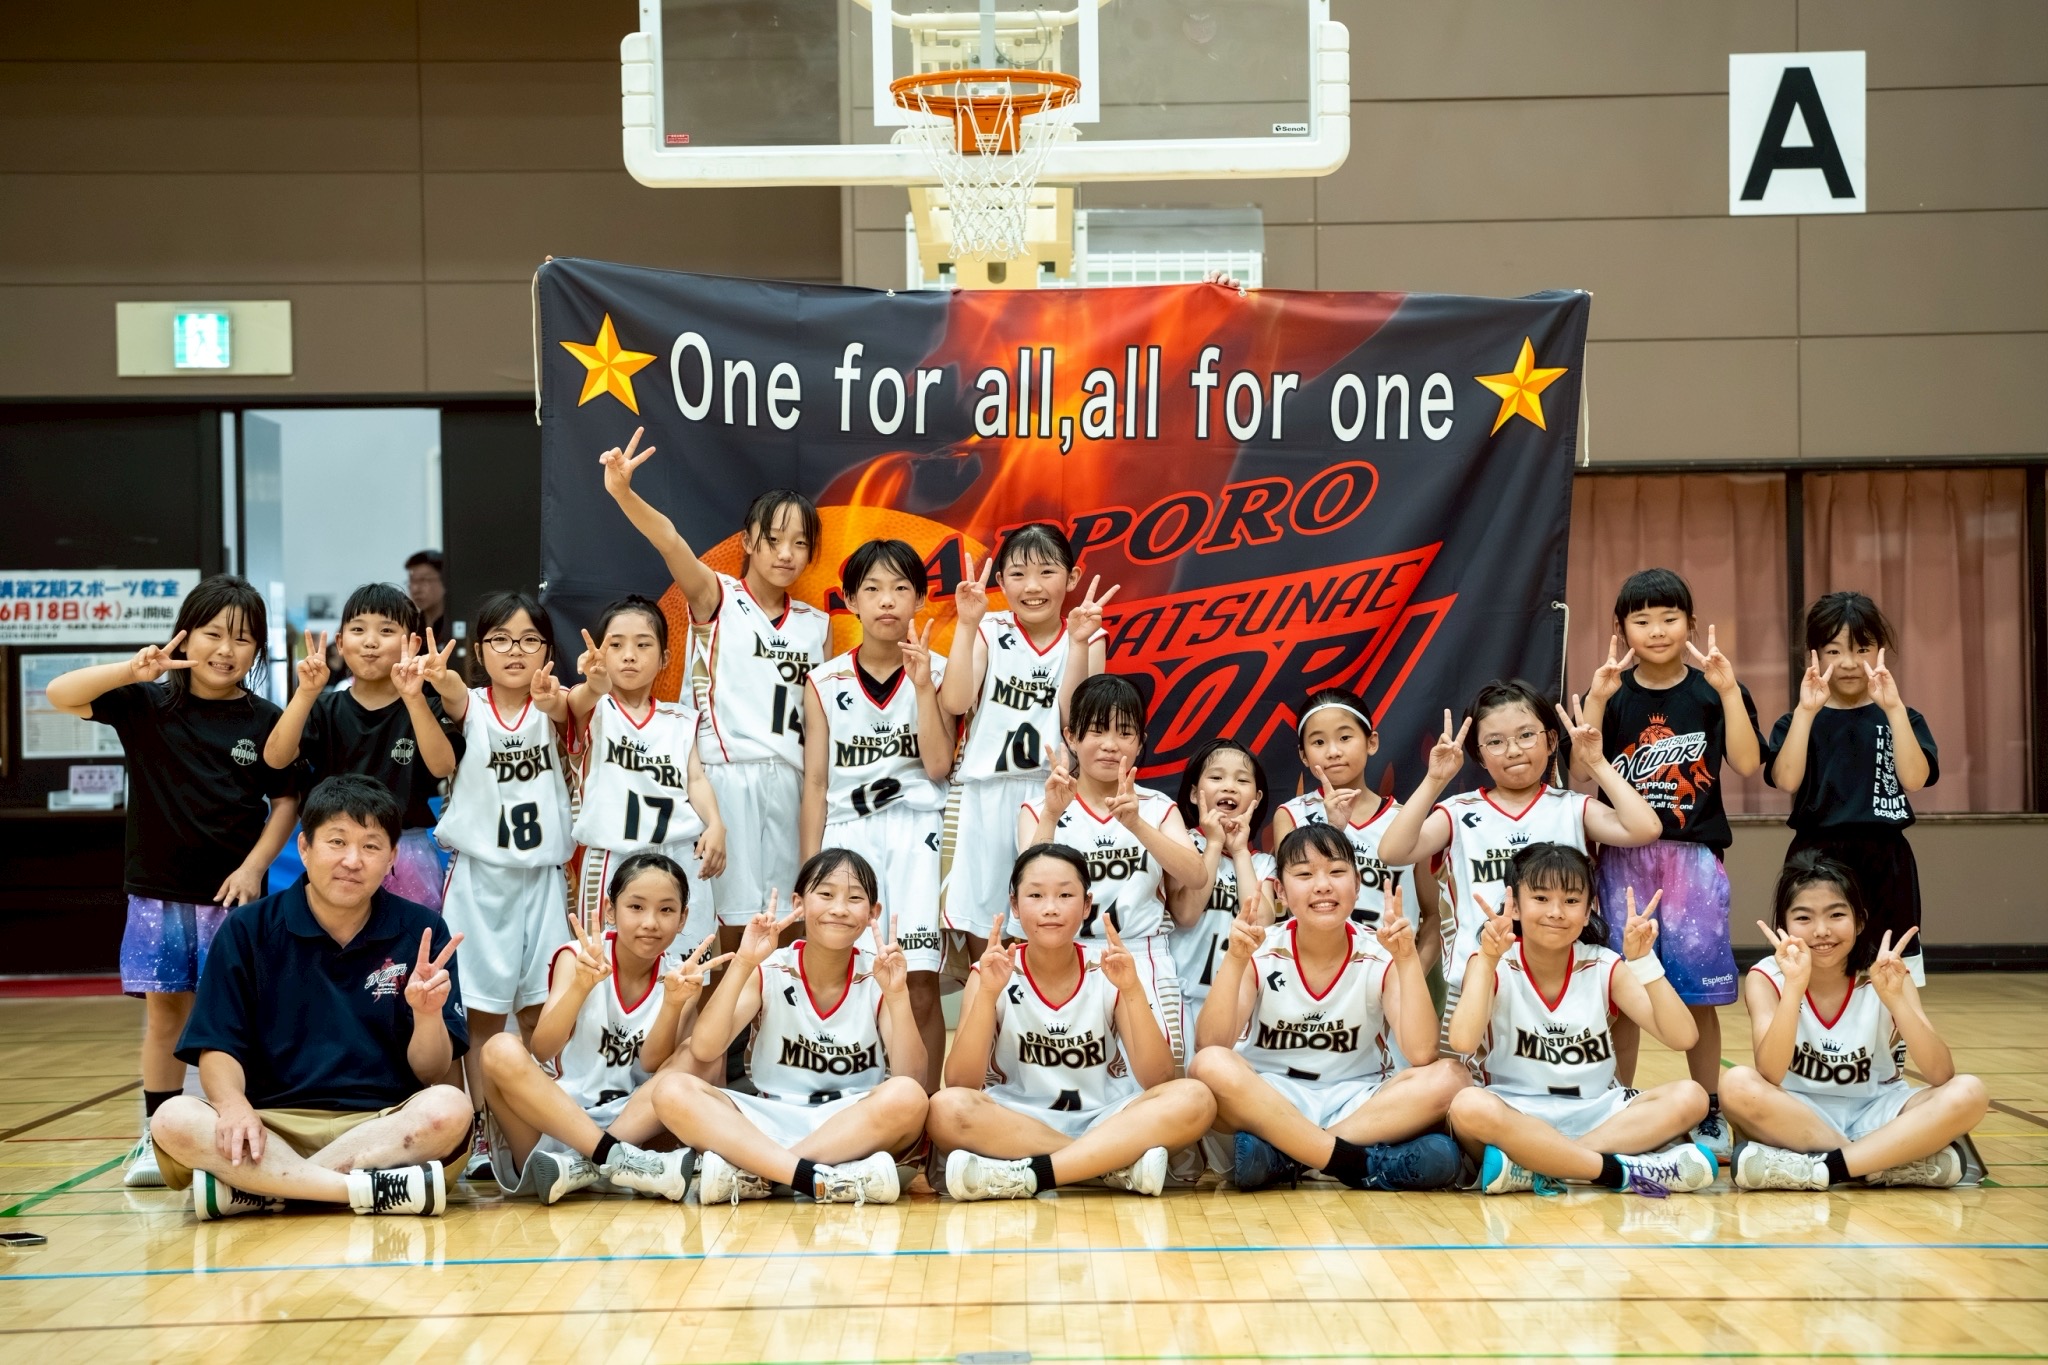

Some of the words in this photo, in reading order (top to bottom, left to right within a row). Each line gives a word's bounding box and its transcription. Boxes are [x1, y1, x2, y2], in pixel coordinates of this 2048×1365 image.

[1740, 67, 1856, 201] A
[670, 331, 801, 431] One
[834, 342, 943, 436] for
[974, 345, 1161, 455] all,all
[1190, 346, 1299, 441] for
[1330, 370, 1454, 442] one
[824, 460, 1380, 616] APORO
[1010, 676, 1049, 692] SATSU
[852, 723, 910, 746] SATSUNAE
[994, 721, 1042, 773] 10
[1654, 733, 1705, 750] SATSUNAE
[231, 748, 258, 762] MIDORI
[1611, 742, 1707, 781] MIDORI
[1635, 781, 1678, 792] SAPPORO
[1873, 794, 1906, 810] POINT
[498, 801, 543, 851] 18
[623, 788, 674, 845] 17
[1083, 846, 1139, 861] ATSUNAE
[1089, 849, 1149, 882] DORI
[1026, 1030, 1094, 1049] SATSUNAE
[1254, 1020, 1362, 1053] MIDORI
[1276, 1019, 1344, 1032] SATSUNAE
[777, 1036, 880, 1076] MIDORI
[798, 1033, 861, 1056] SATSUNAE
[1017, 1033, 1107, 1069] MIDORI
[1514, 1026, 1612, 1065] MIDORI
[1788, 1043, 1874, 1085] MIDOR
